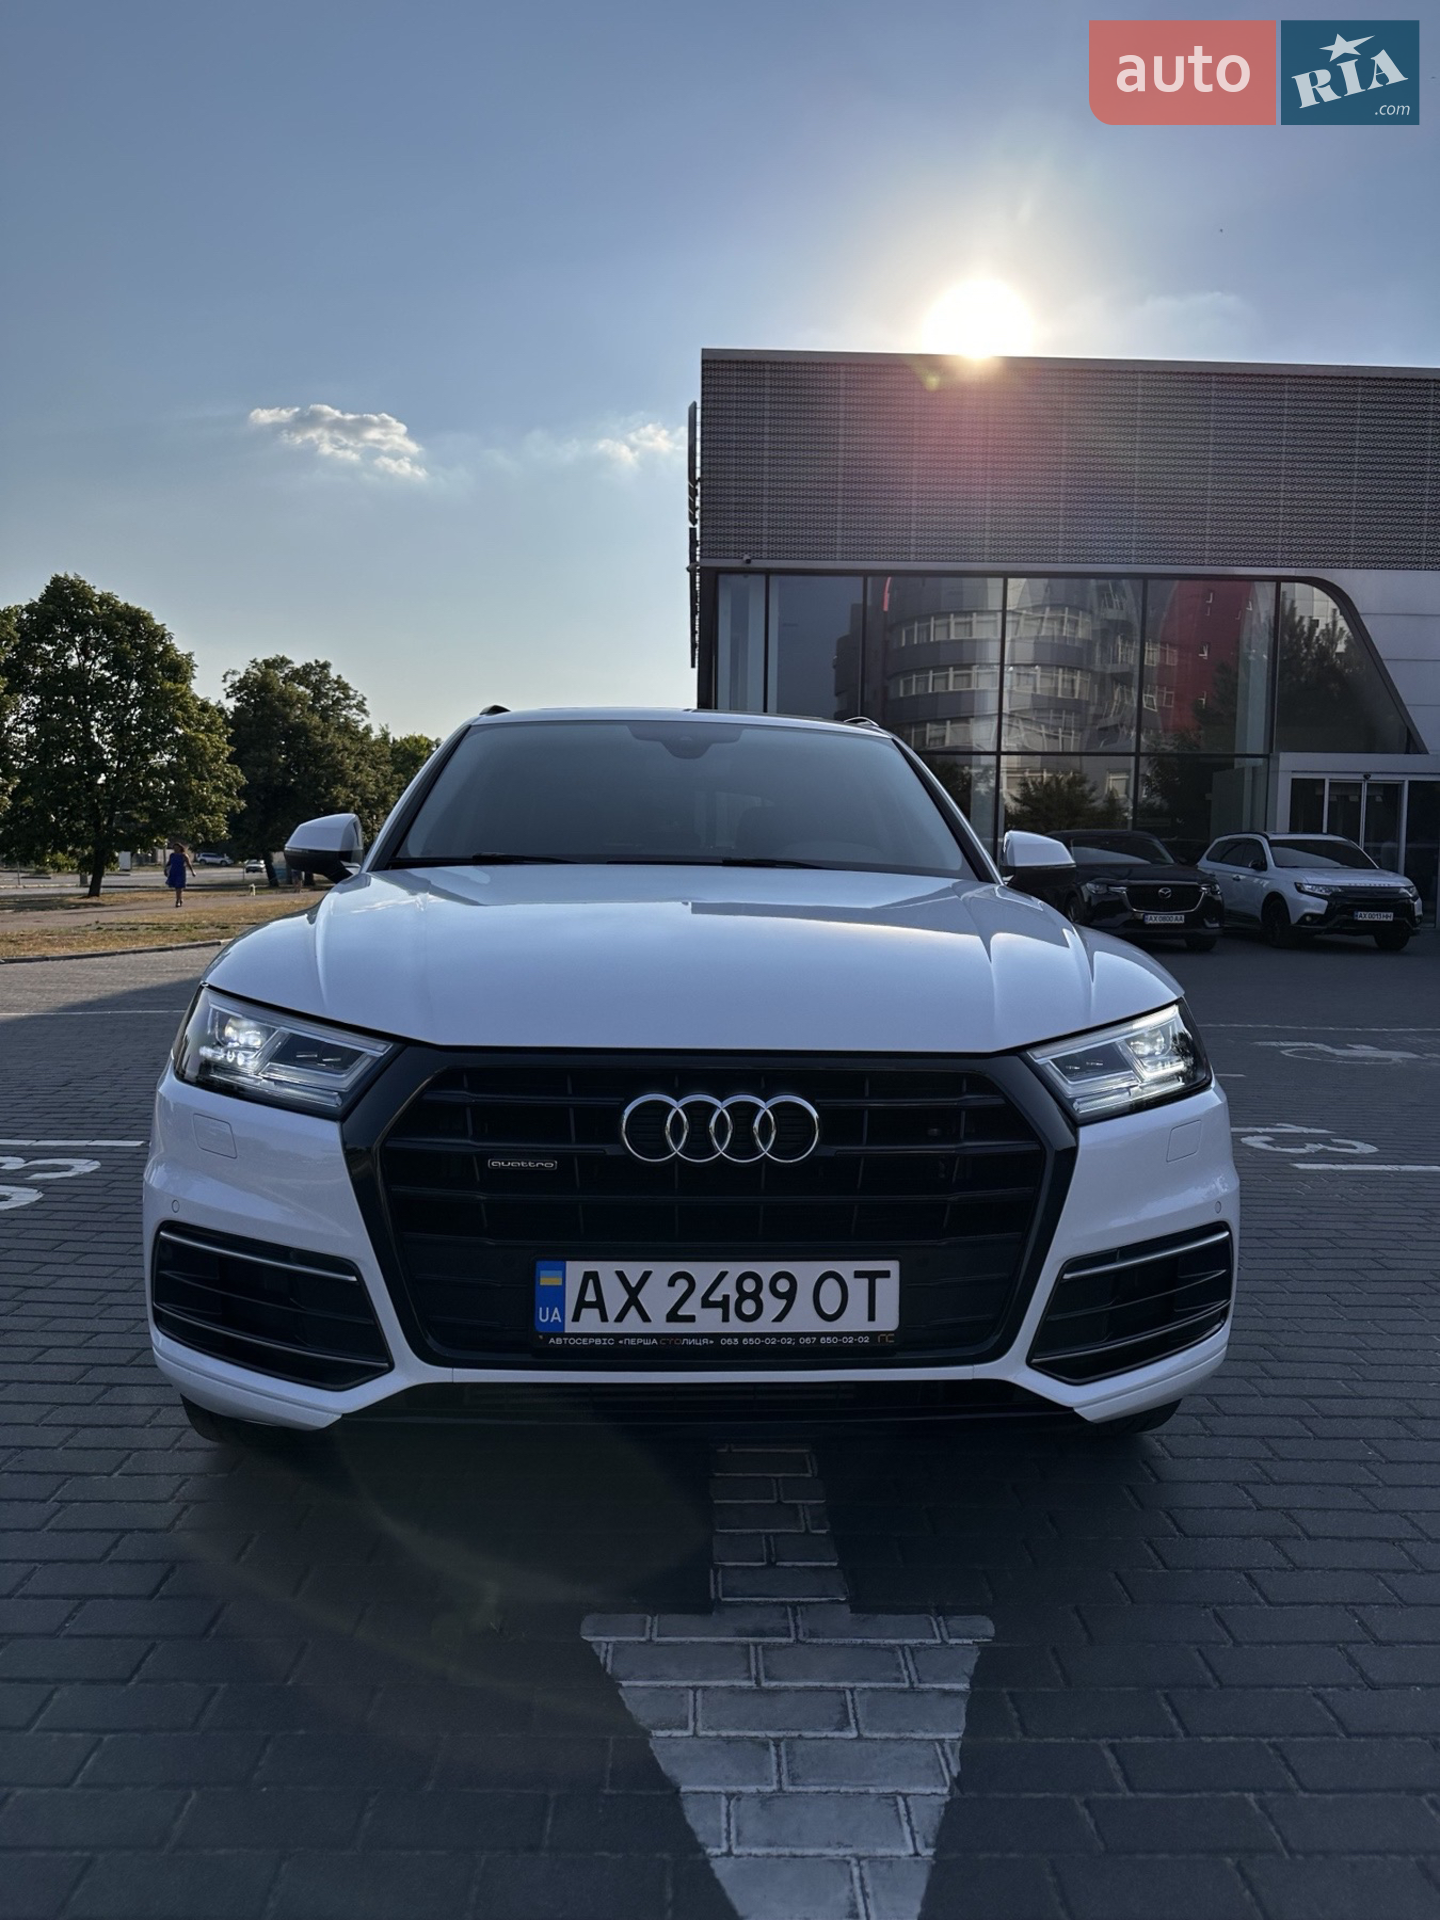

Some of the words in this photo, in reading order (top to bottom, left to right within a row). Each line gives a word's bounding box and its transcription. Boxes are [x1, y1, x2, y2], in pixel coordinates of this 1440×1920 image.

[491, 1160, 554, 1169] quattro
[571, 1270, 653, 1323] AX
[665, 1270, 798, 1323] 2489
[812, 1270, 891, 1323] OT
[538, 1306, 562, 1323] UA
[548, 1337, 615, 1345] АВТОСЕРВІС
[618, 1337, 658, 1345] «ПЕРША
[720, 1337, 739, 1345] 063
[799, 1337, 817, 1345] 067
[820, 1336, 870, 1344] 650-02-02
